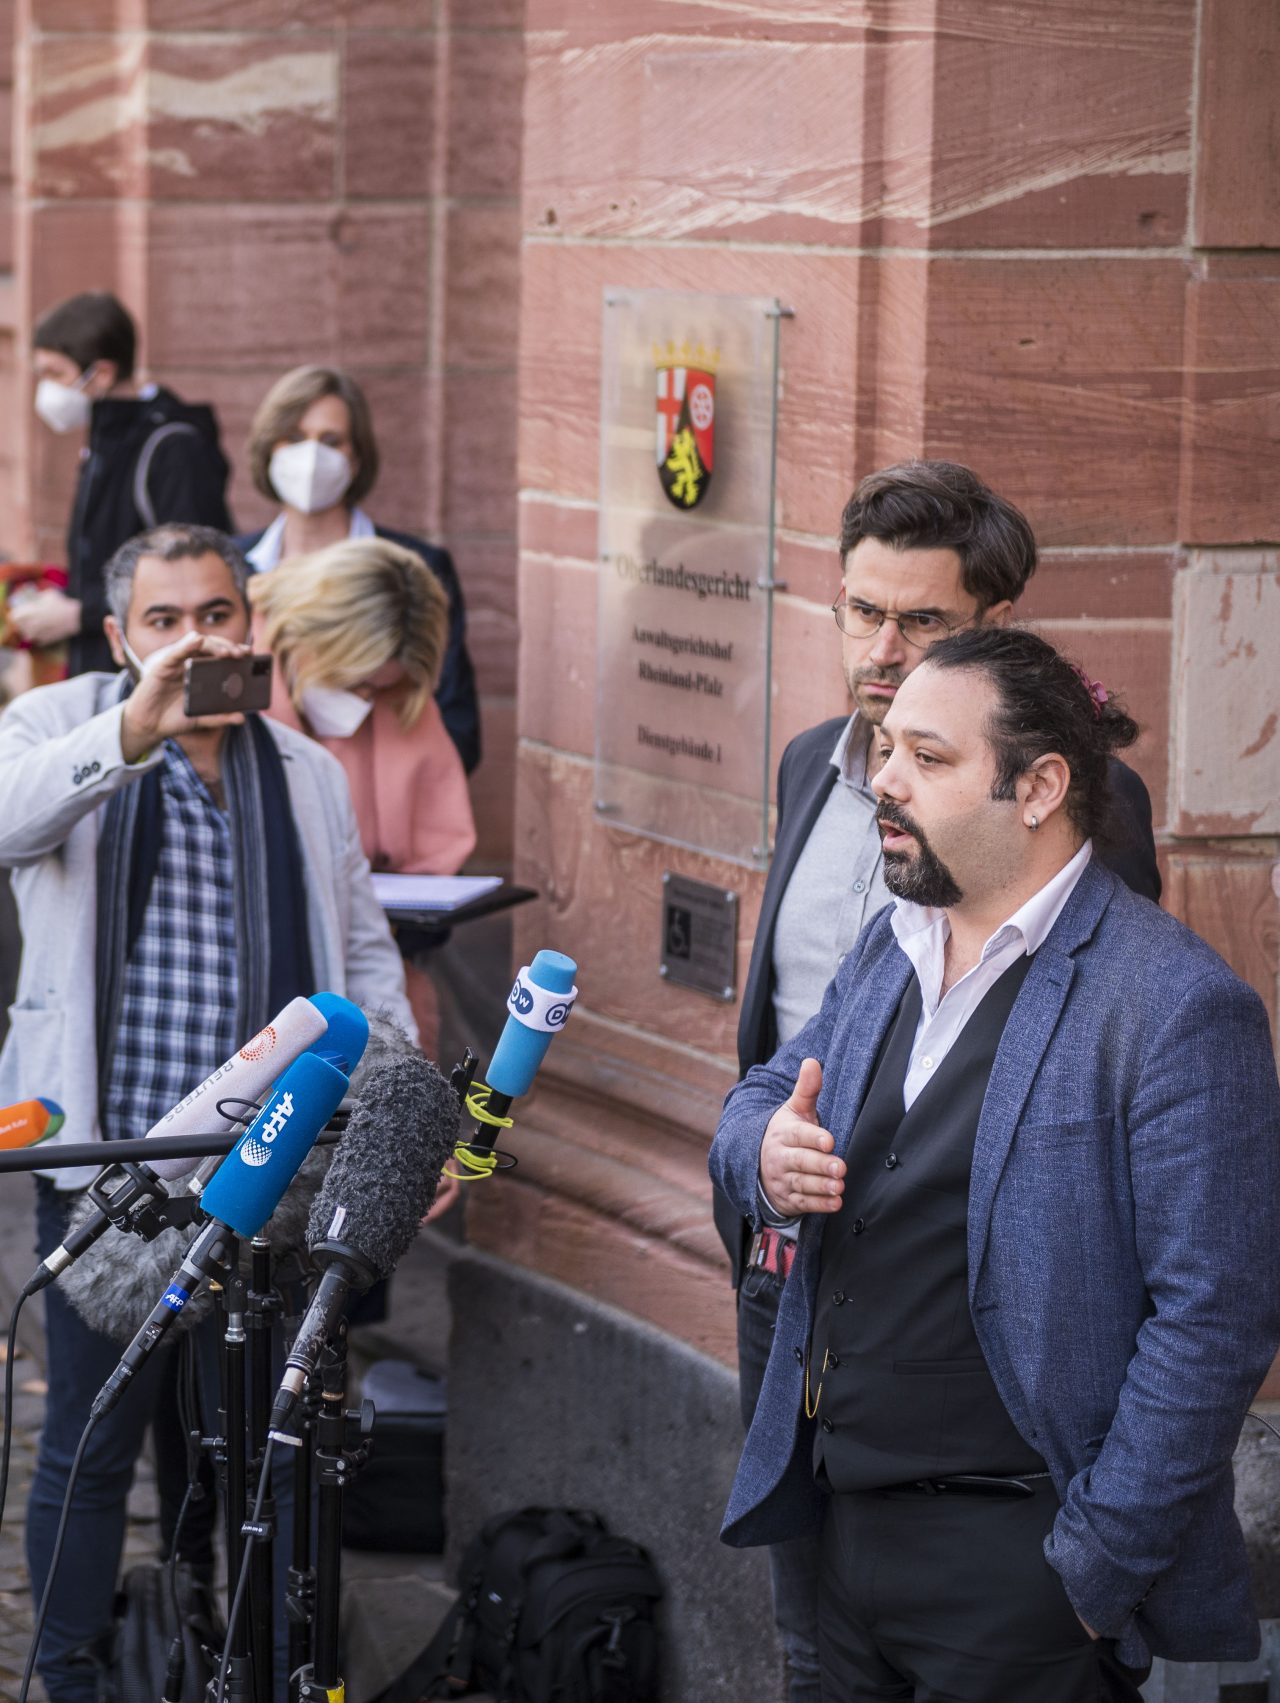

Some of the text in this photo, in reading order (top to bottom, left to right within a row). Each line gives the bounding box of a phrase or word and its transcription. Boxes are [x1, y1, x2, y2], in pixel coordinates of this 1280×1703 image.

[616, 554, 750, 602] Oberlandesgericht
[638, 659, 723, 697] Rheinland-Pfalz
[510, 981, 532, 1011] DW
[165, 1061, 234, 1122] REUTERS
[261, 1091, 294, 1143] AFP
[165, 1293, 184, 1307] AFP
